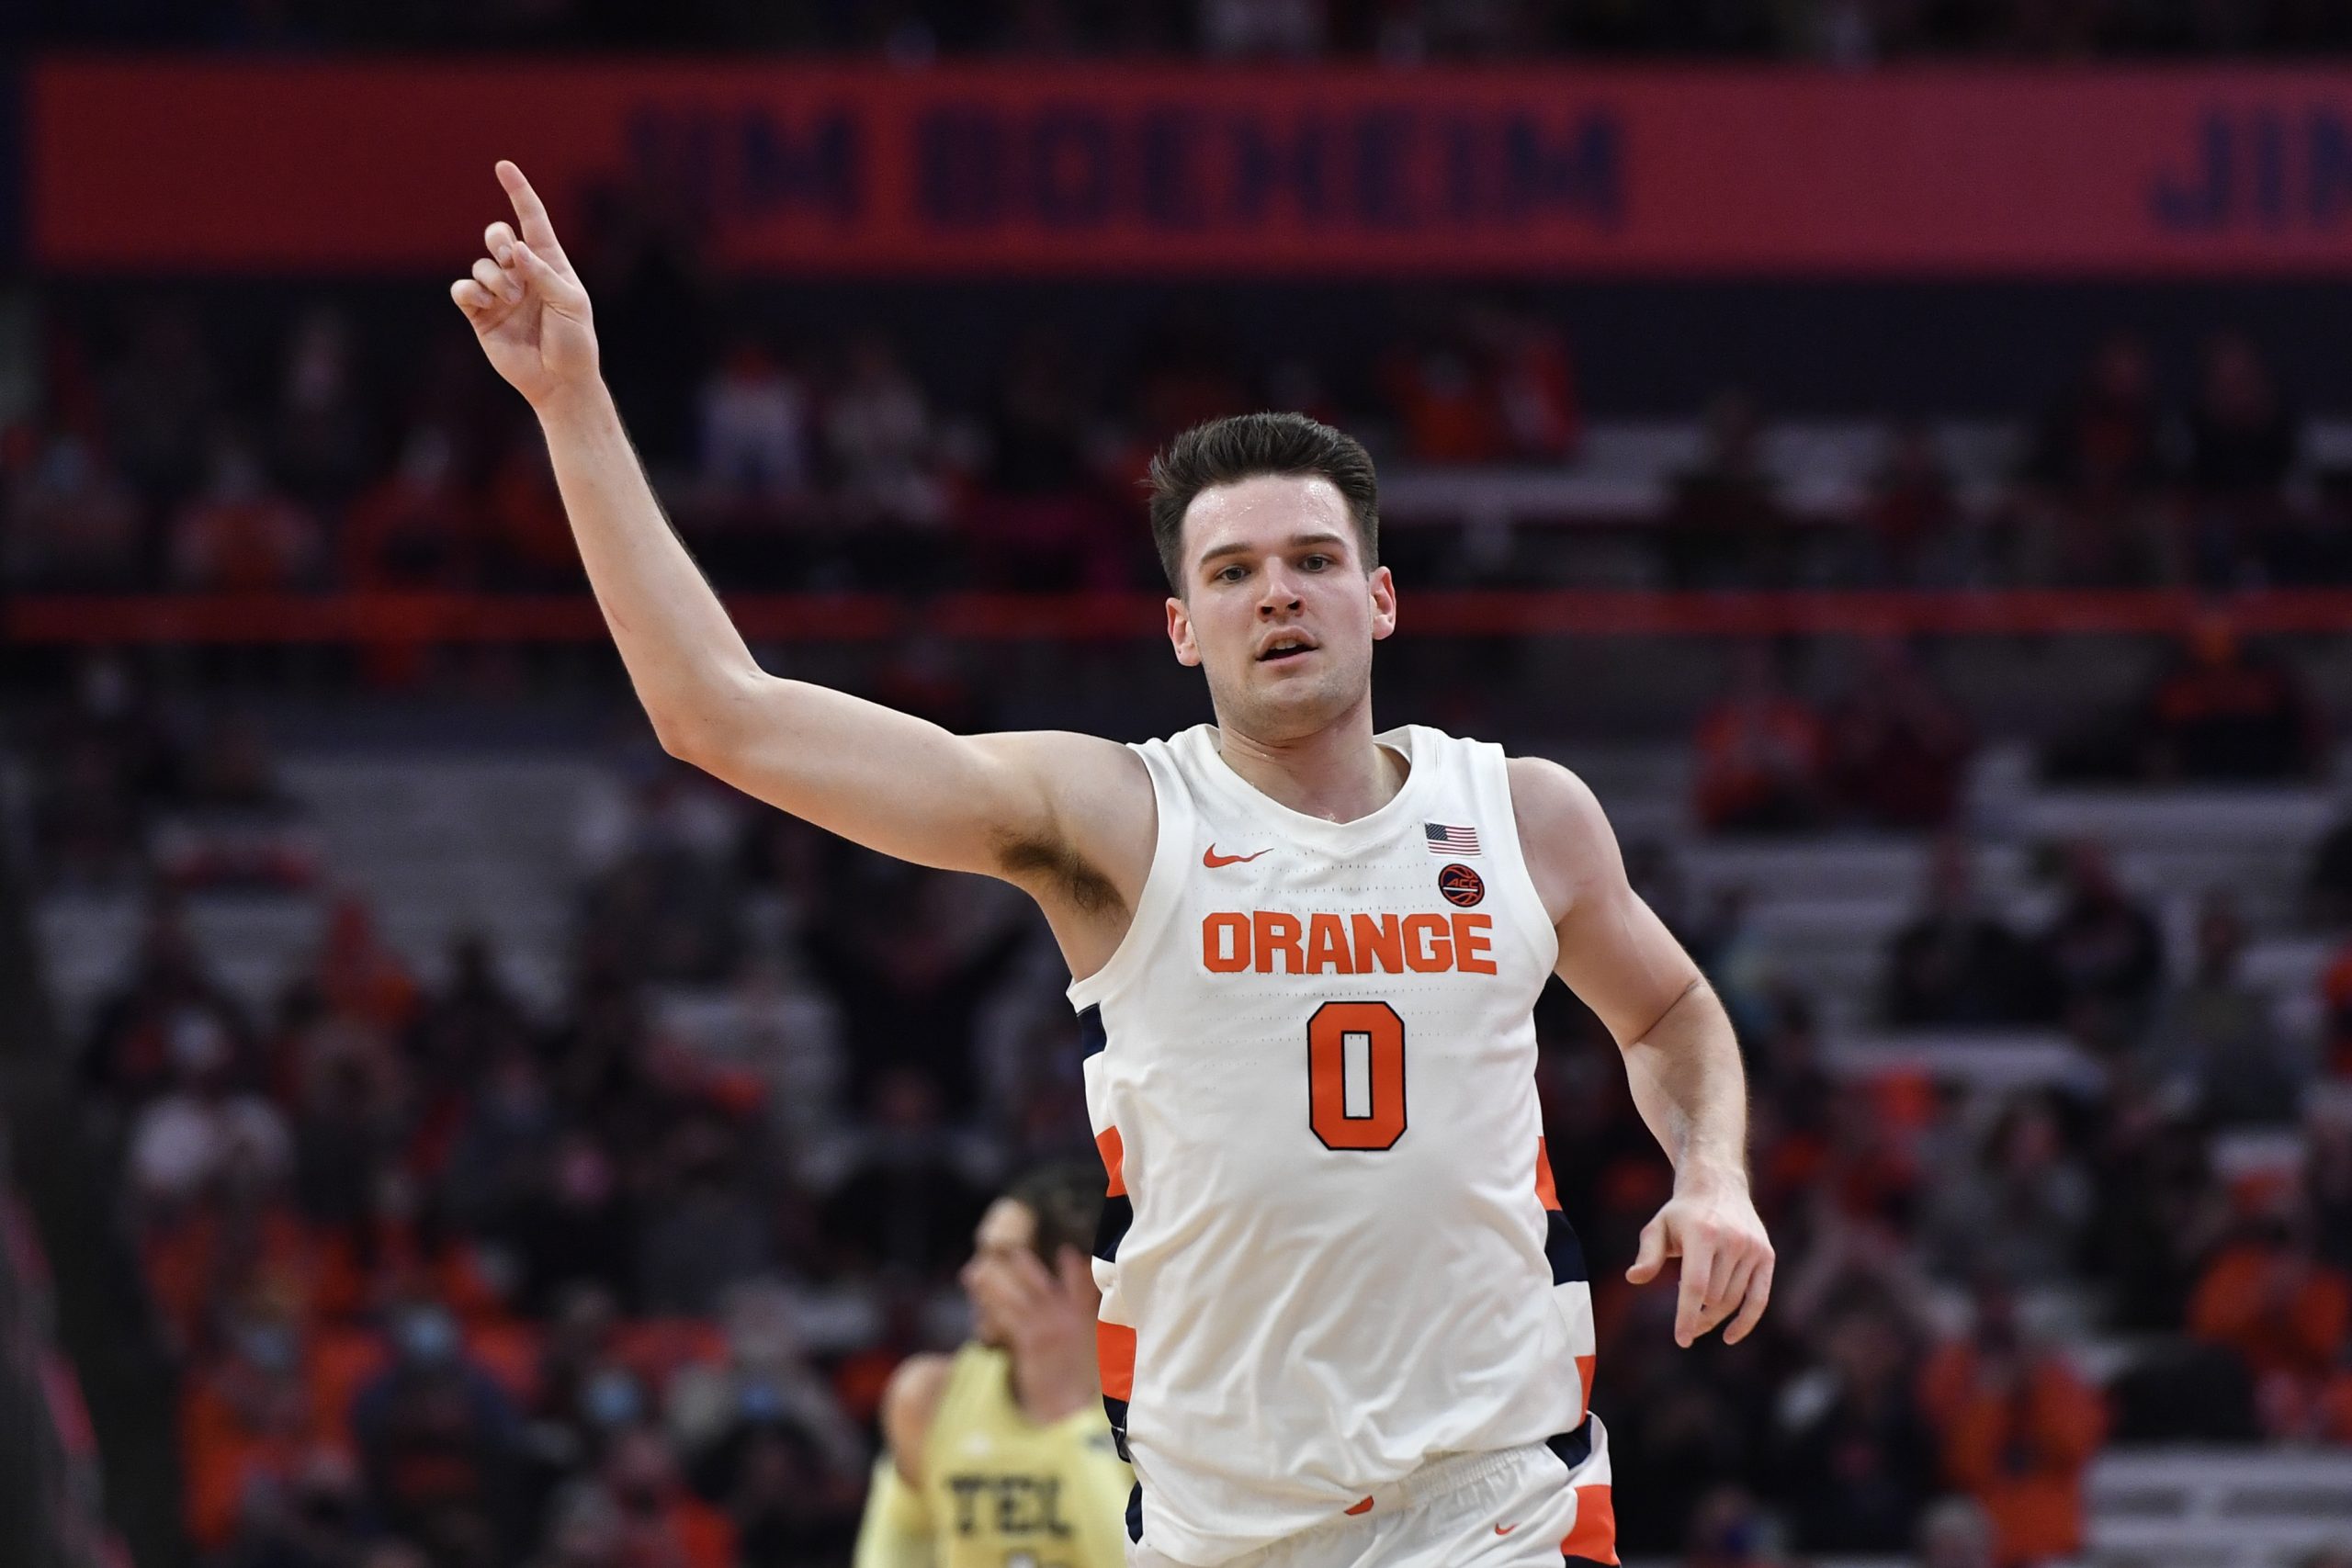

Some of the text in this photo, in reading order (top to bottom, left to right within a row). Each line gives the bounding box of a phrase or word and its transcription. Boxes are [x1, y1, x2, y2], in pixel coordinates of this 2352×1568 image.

[1446, 877, 1479, 889] ACC
[1203, 910, 1498, 975] ORANGE
[1306, 1001, 1408, 1151] 0
